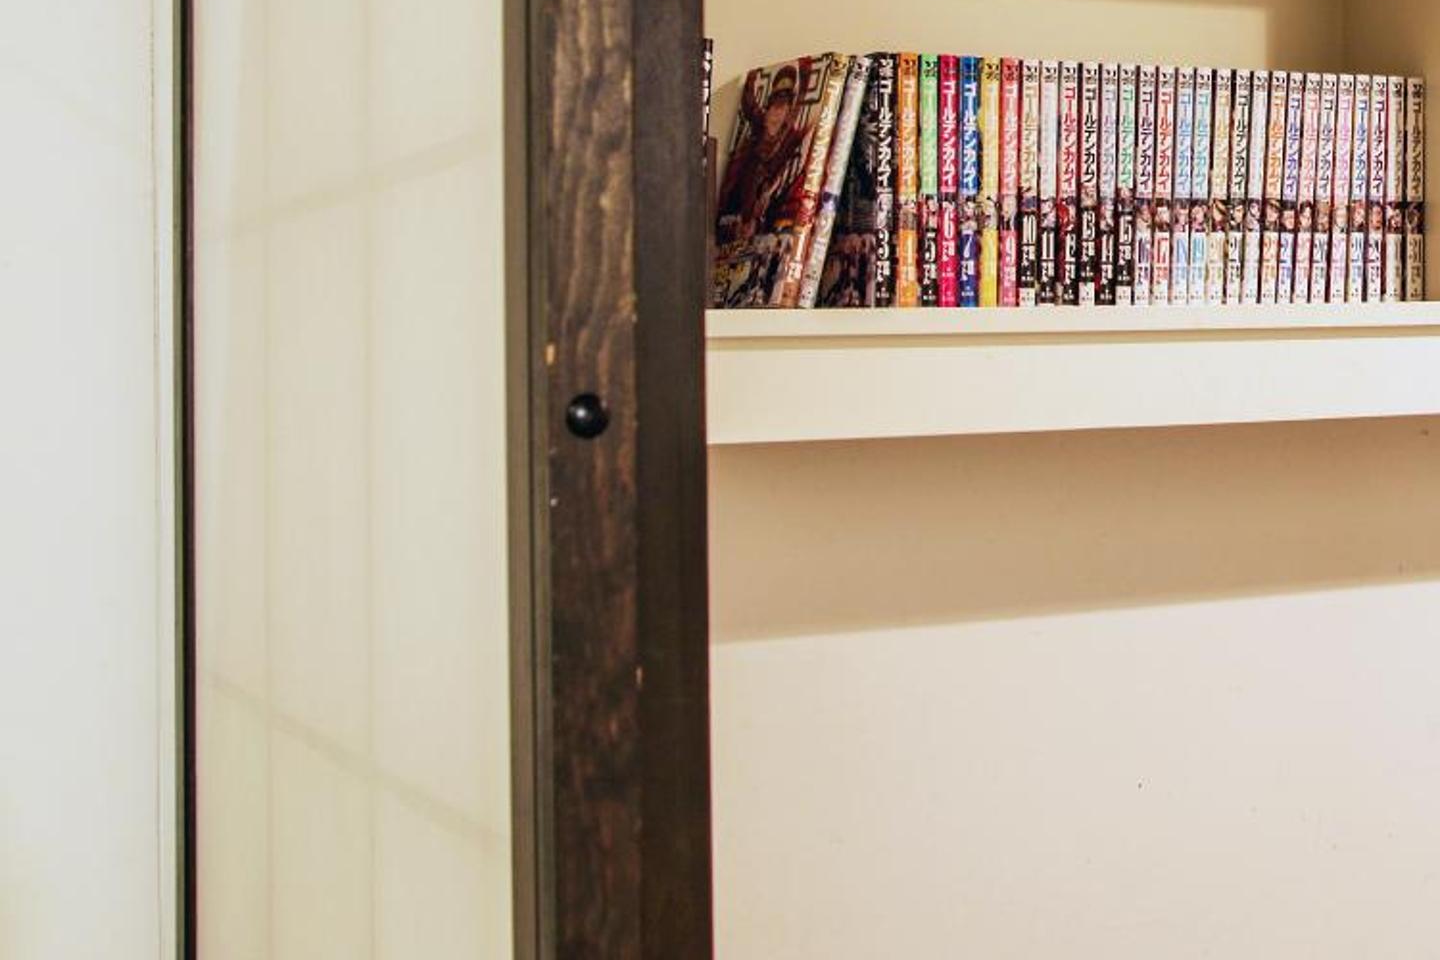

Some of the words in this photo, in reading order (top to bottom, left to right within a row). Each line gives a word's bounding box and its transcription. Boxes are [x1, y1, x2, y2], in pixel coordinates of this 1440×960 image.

[878, 78, 893, 188] ゴールデンカムイ
[940, 80, 956, 189] ゴールデンカムイ
[963, 81, 978, 192] ゴールデンカムイ
[1064, 87, 1077, 189] ゴールデンカムイ
[1140, 90, 1154, 191] ゴールデンカムイ
[1159, 91, 1174, 191] ゴールデンカムイ
[1178, 92, 1193, 191] ゴールデンカムイ
[1196, 92, 1211, 191] ゴールデンカムイ
[1234, 95, 1250, 191] ゴールデンカムイ
[1286, 97, 1301, 193] ゴールデンカムイ
[1354, 100, 1368, 193] ゴールデンカムイ
[1371, 100, 1386, 194] ゴールデンカムイ
